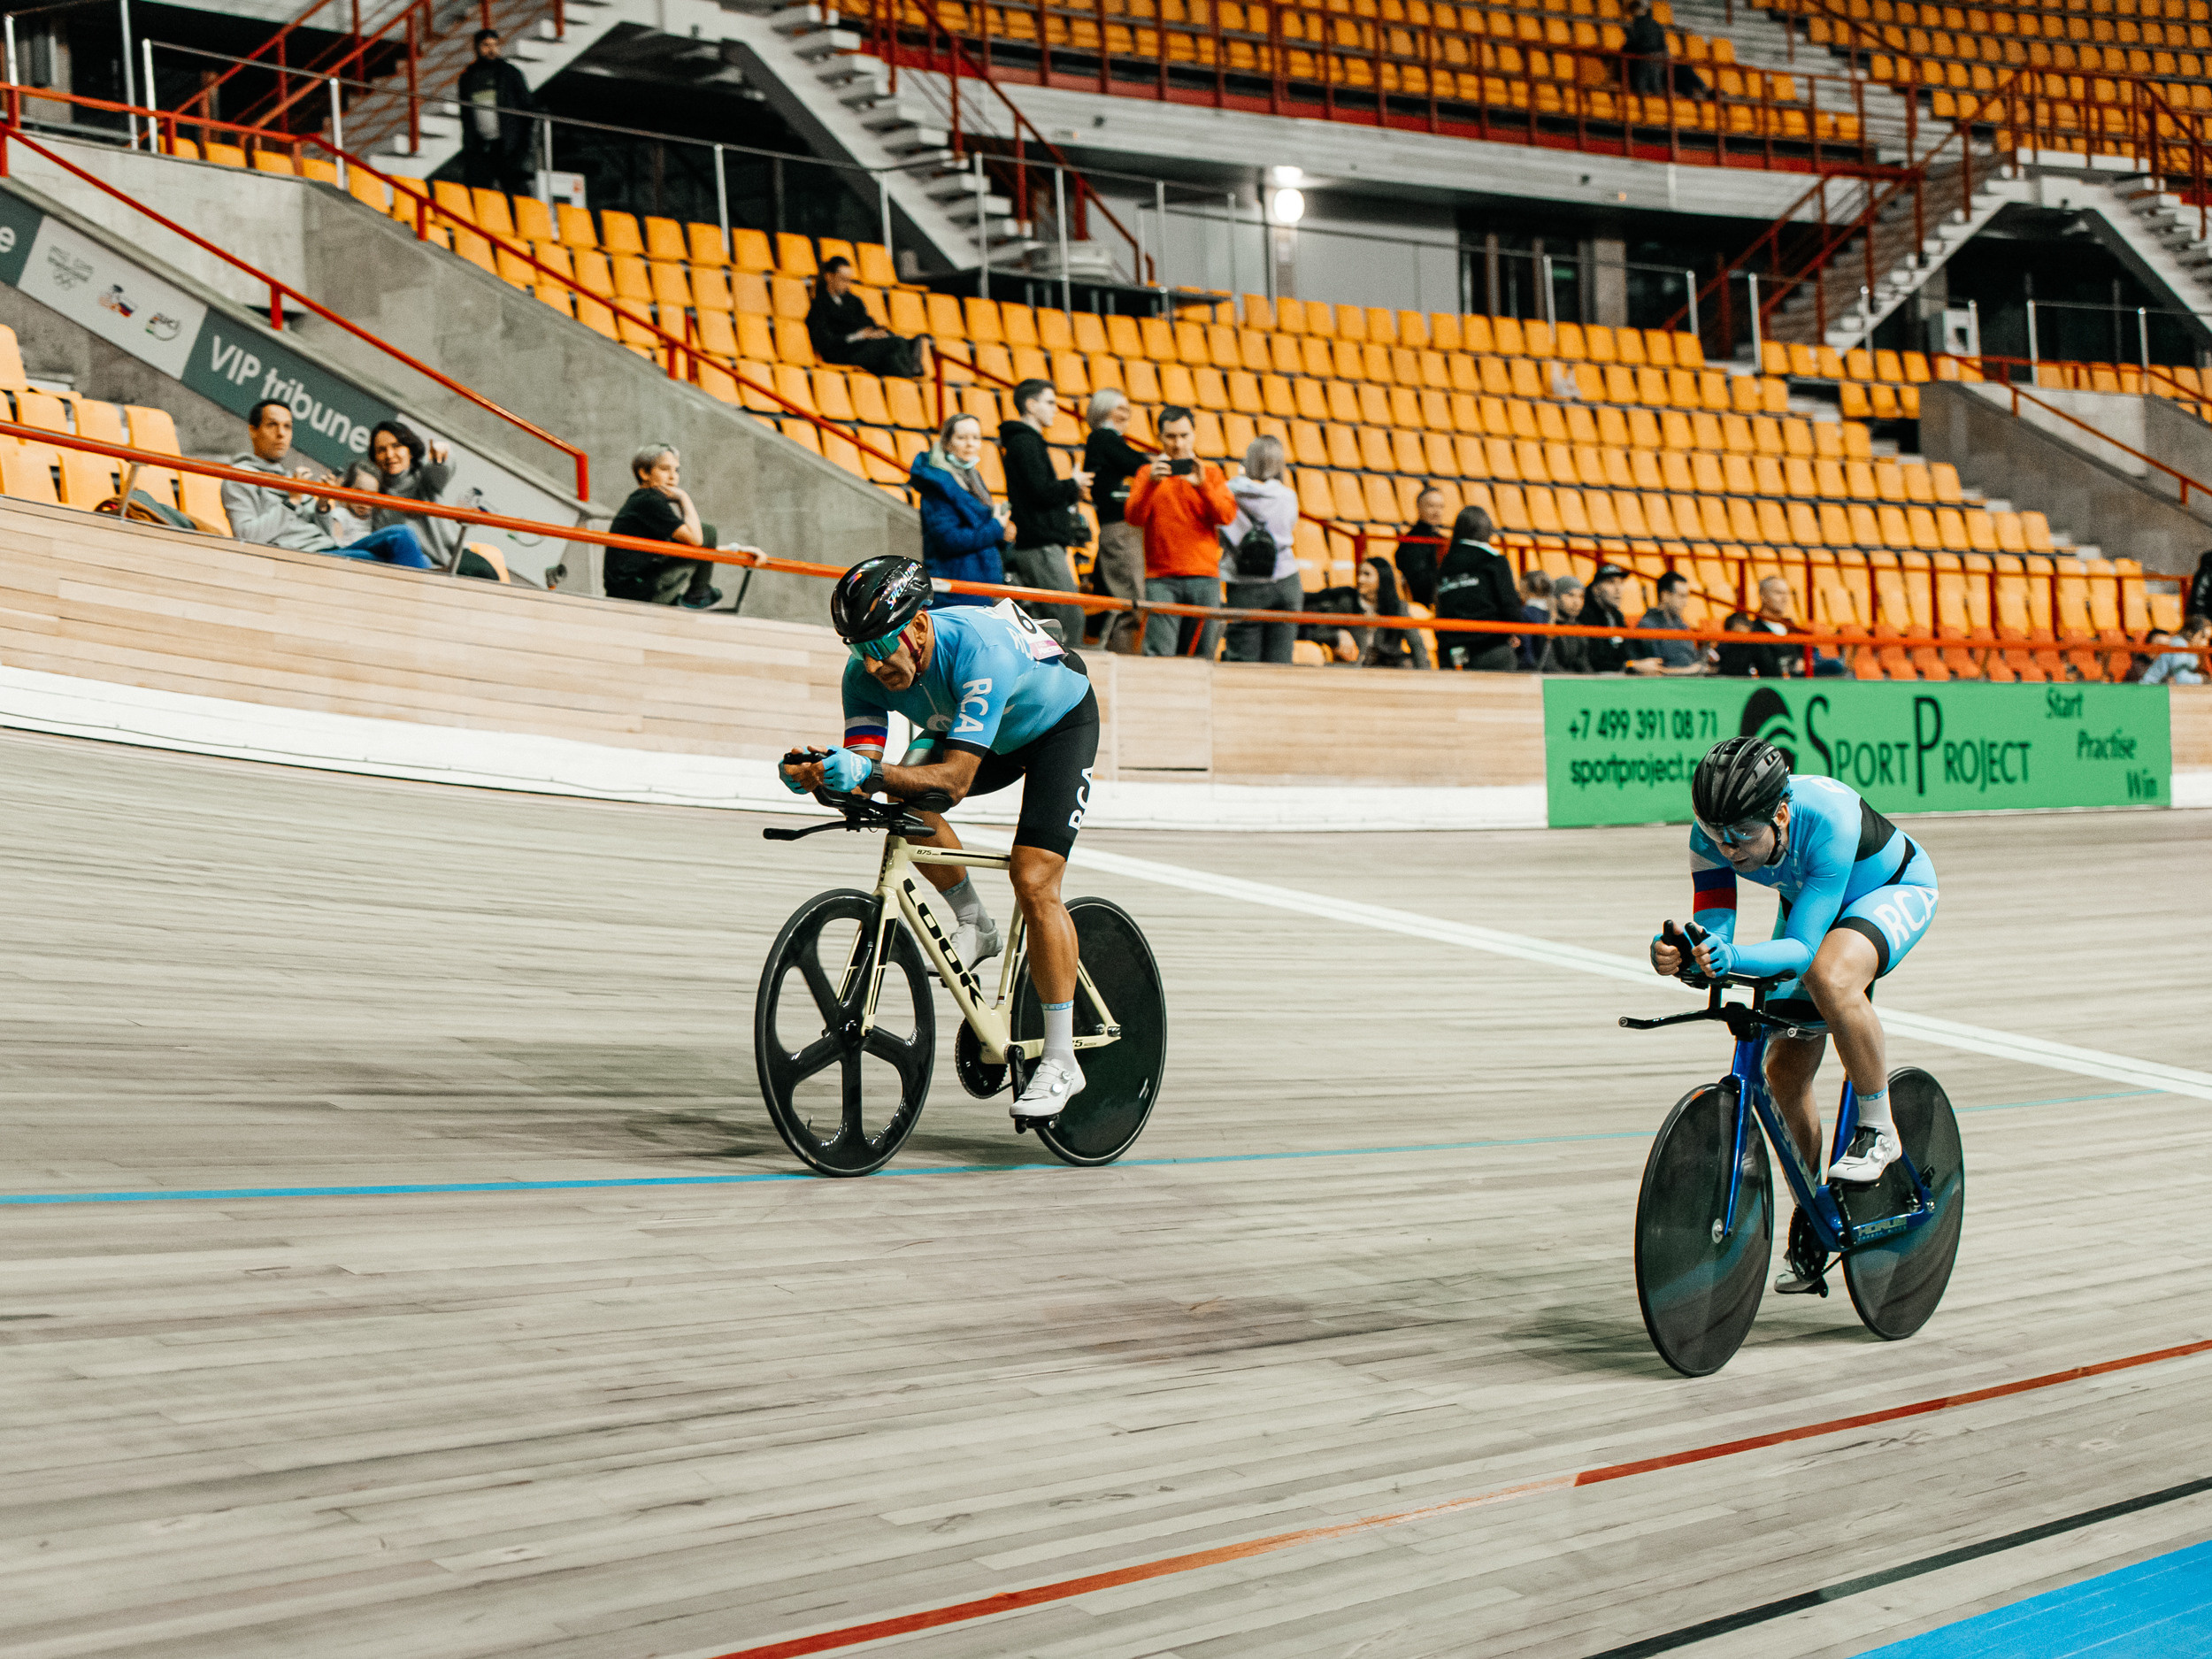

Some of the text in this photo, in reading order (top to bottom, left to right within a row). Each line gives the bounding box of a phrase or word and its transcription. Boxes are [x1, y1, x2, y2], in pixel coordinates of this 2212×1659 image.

[211, 334, 371, 454] VIP tribune
[1011, 603, 1037, 634] 6
[954, 678, 992, 733] RCA
[2047, 687, 2083, 719] Start
[1569, 710, 1718, 740] +7 499 391 08 71
[2127, 768, 2157, 799] Win
[1873, 885, 1939, 951] RCA
[902, 878, 987, 1011] LOOK
